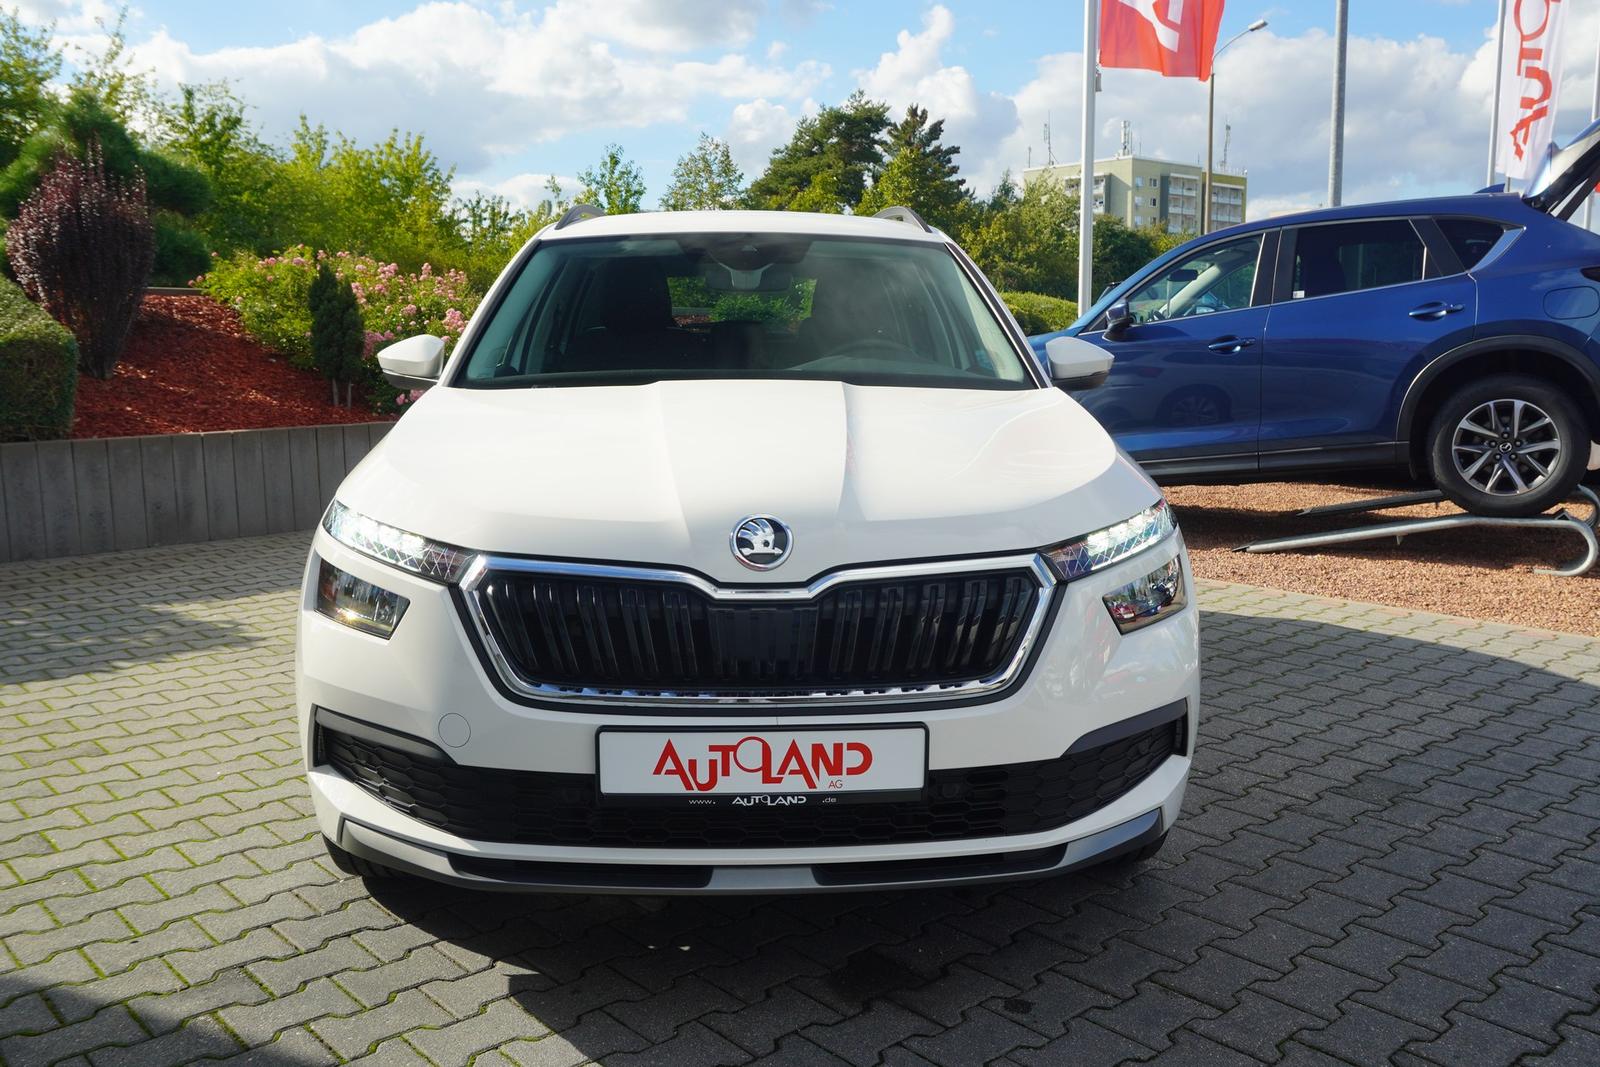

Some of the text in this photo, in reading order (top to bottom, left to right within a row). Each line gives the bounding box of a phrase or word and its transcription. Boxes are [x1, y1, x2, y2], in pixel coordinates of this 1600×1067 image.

[1510, 0, 1561, 161] AUTO
[652, 735, 873, 792] AUTOLAND
[732, 795, 807, 807] AUTOLAND
[828, 779, 843, 790] AG
